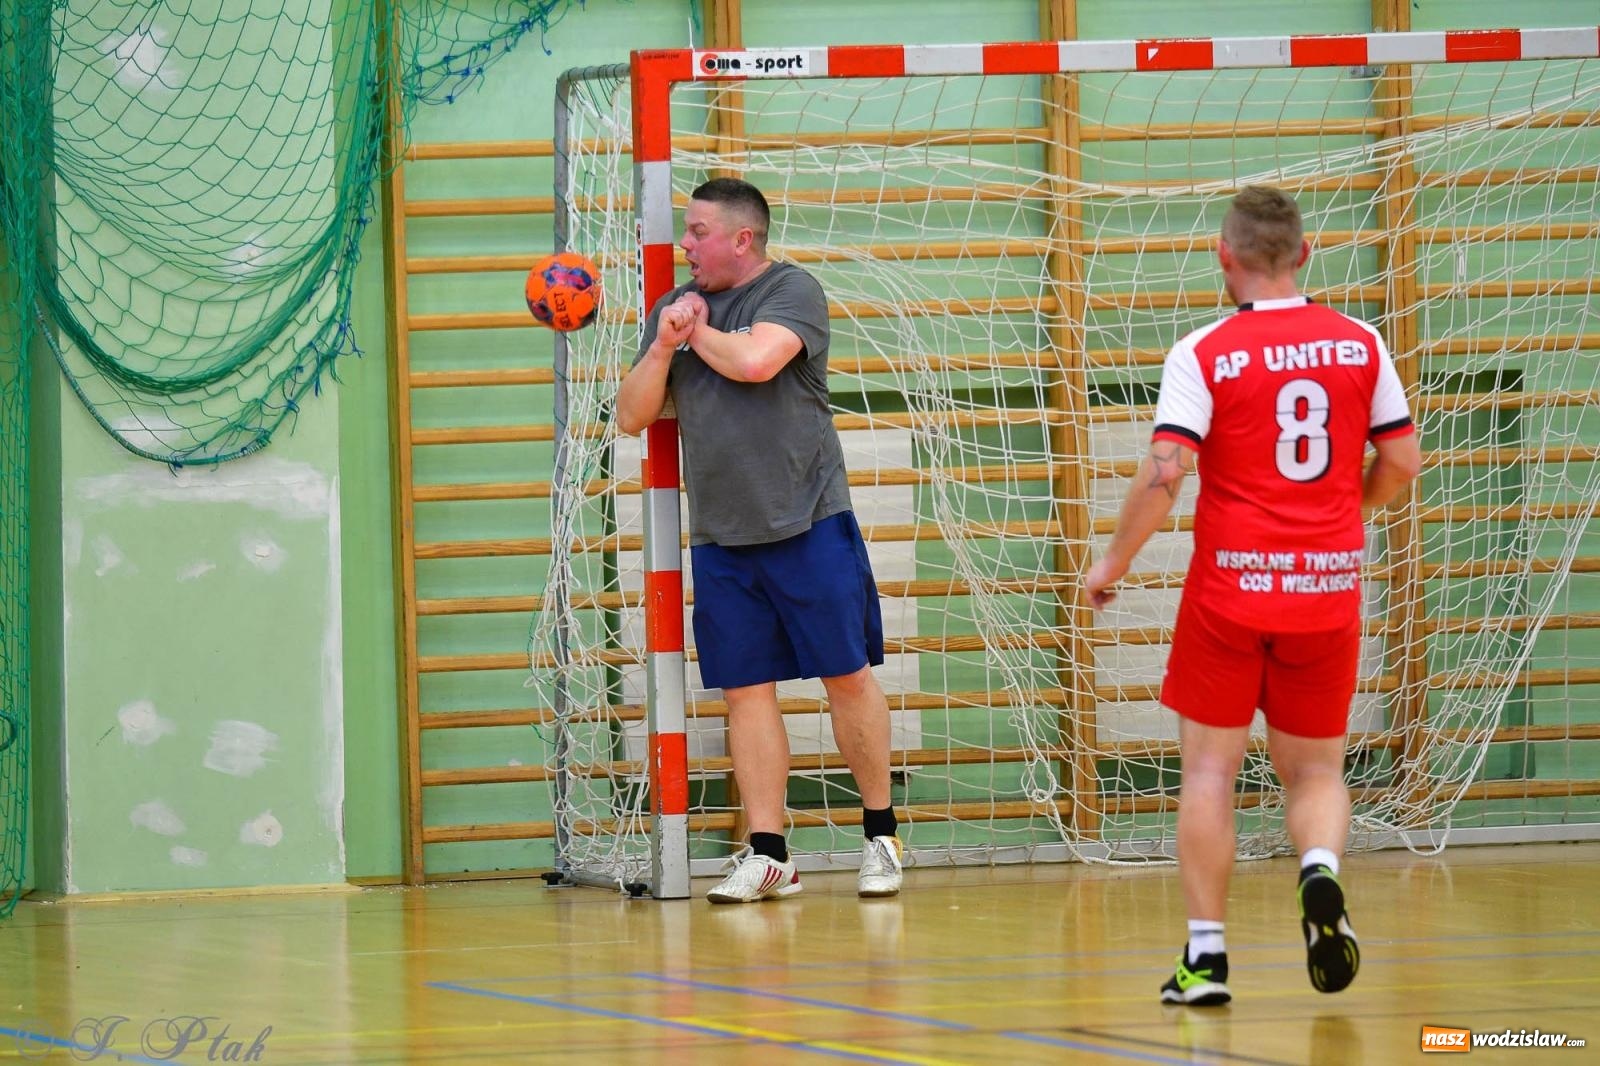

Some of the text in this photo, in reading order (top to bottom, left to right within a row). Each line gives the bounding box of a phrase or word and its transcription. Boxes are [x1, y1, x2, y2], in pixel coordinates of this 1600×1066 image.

[755, 55, 803, 73] sport
[1213, 339, 1369, 383] AP UNITED
[1275, 378, 1331, 482] 8
